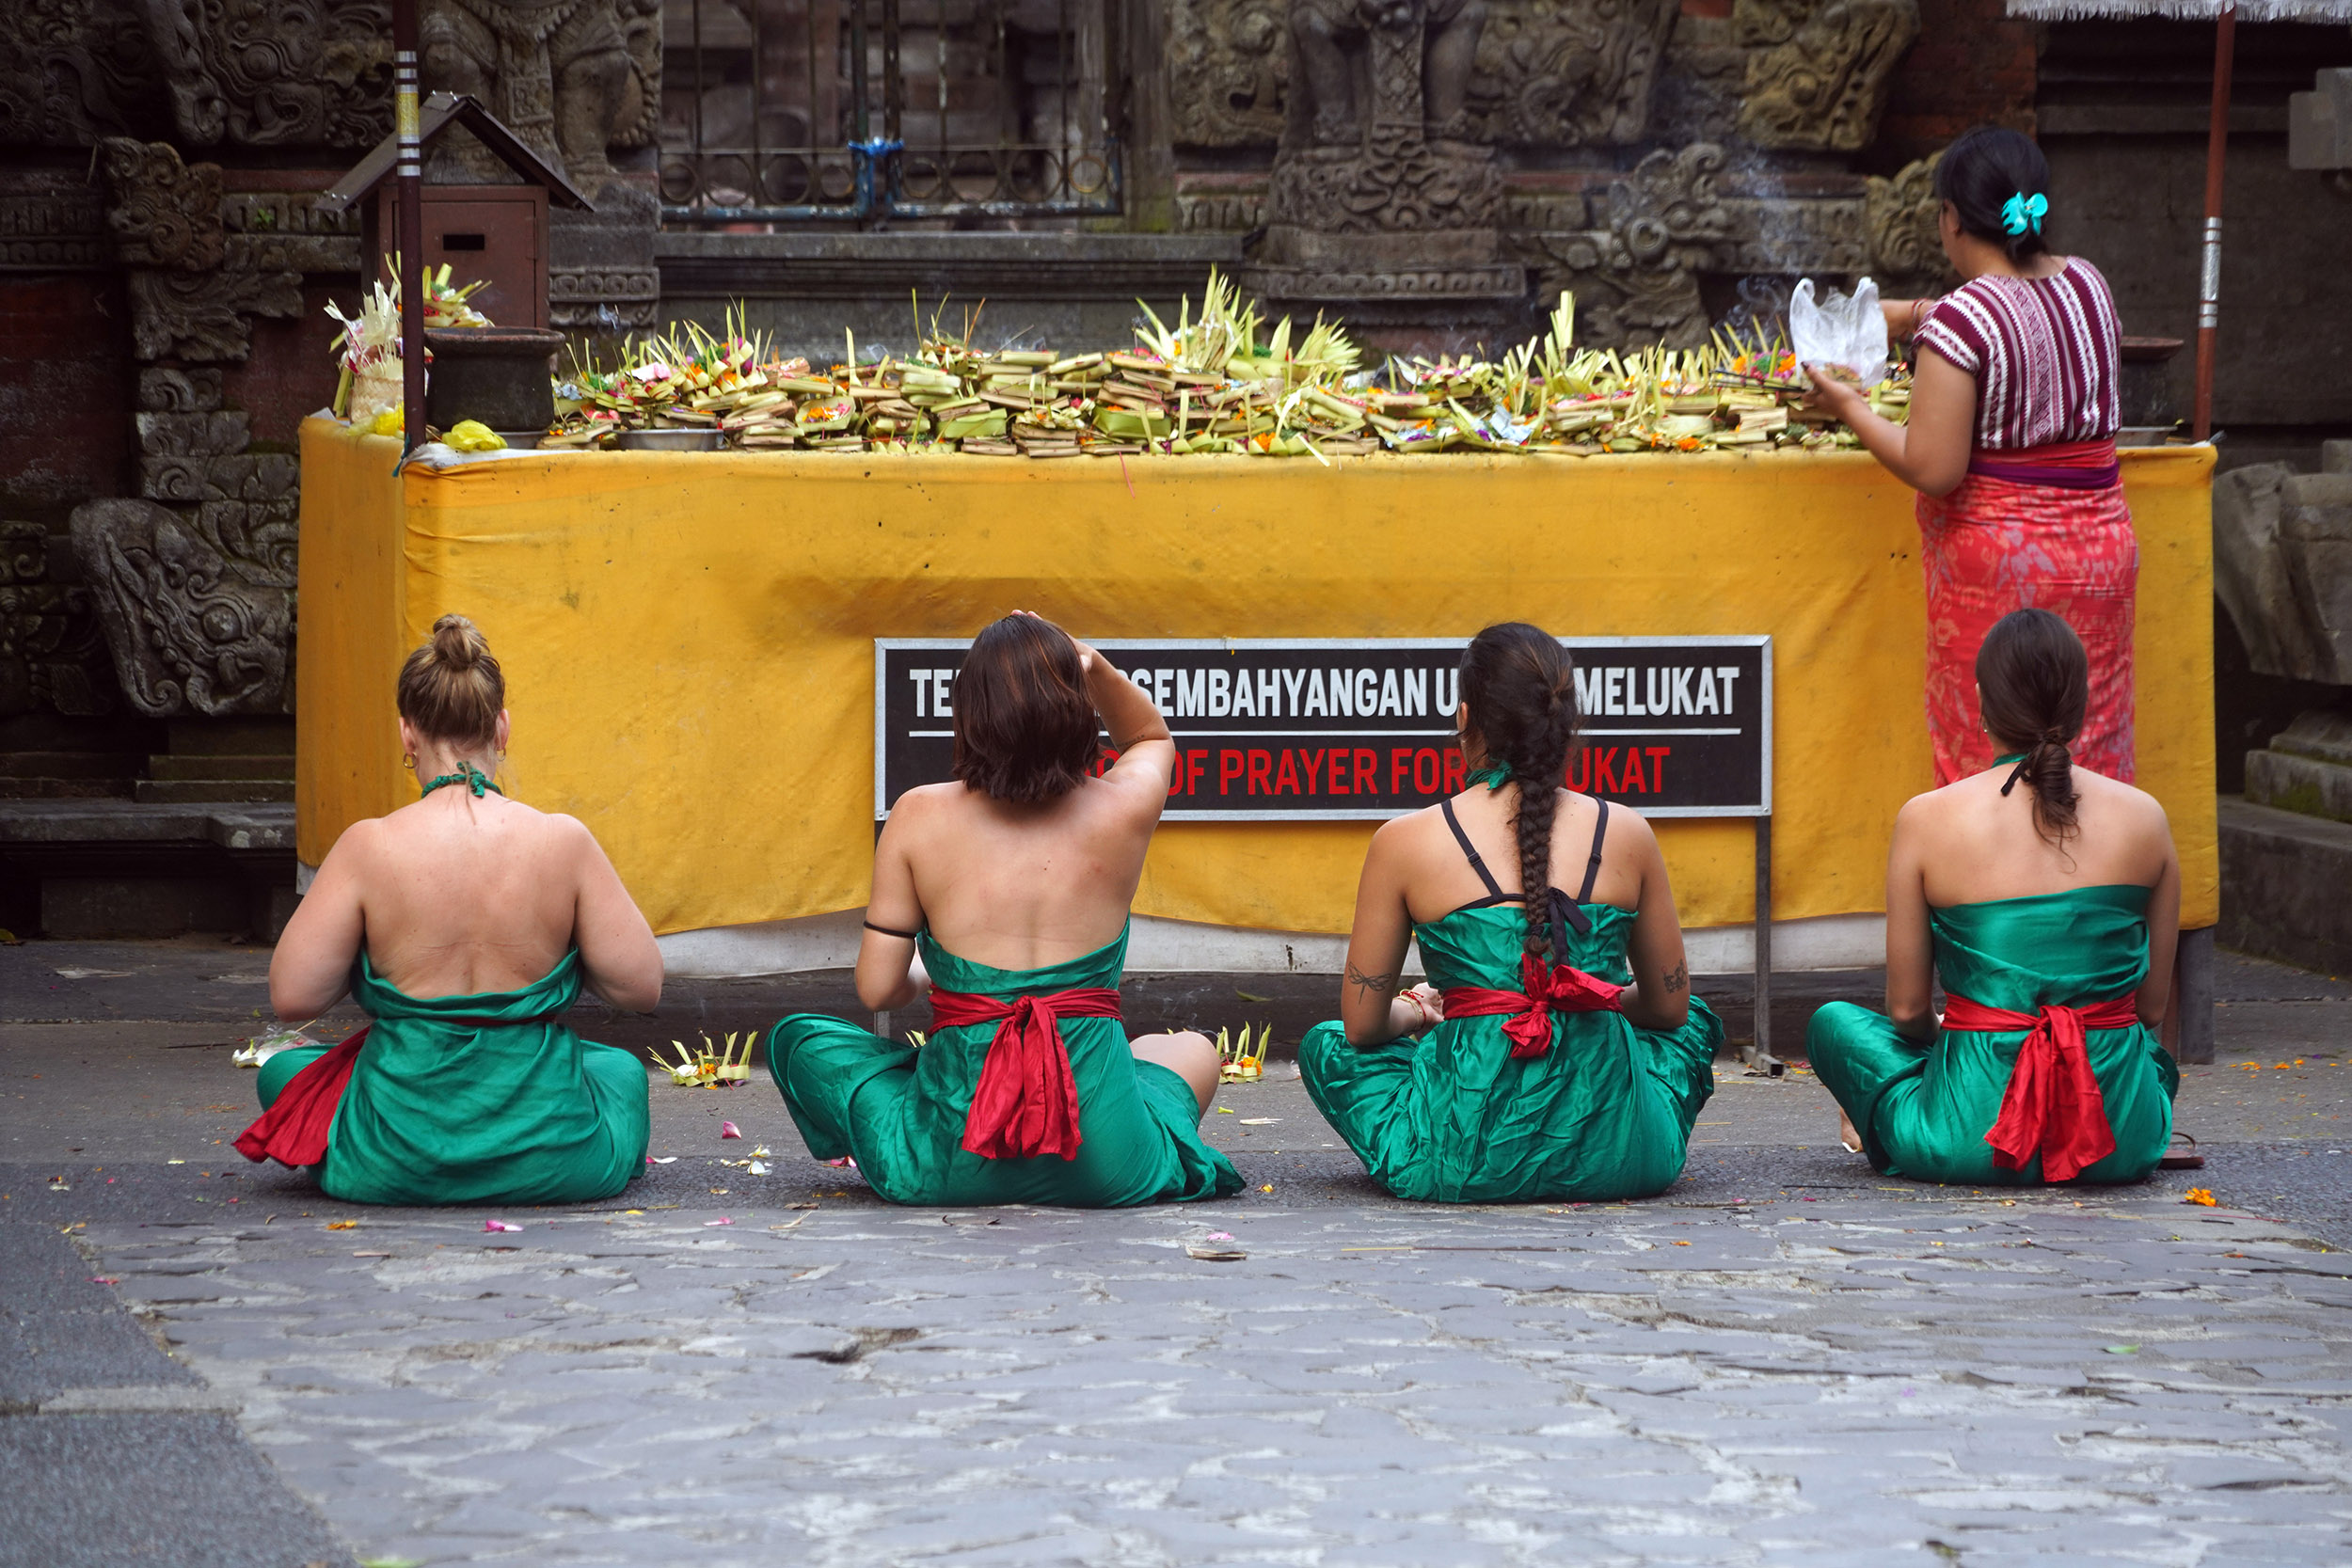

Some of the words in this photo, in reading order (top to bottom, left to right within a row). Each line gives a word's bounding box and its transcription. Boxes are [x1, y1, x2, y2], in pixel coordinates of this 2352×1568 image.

[1573, 667, 1740, 716] MELUKAT
[1220, 749, 1378, 795] PRAYER
[1391, 748, 1468, 794] FOR
[1560, 747, 1670, 794] UKAT
